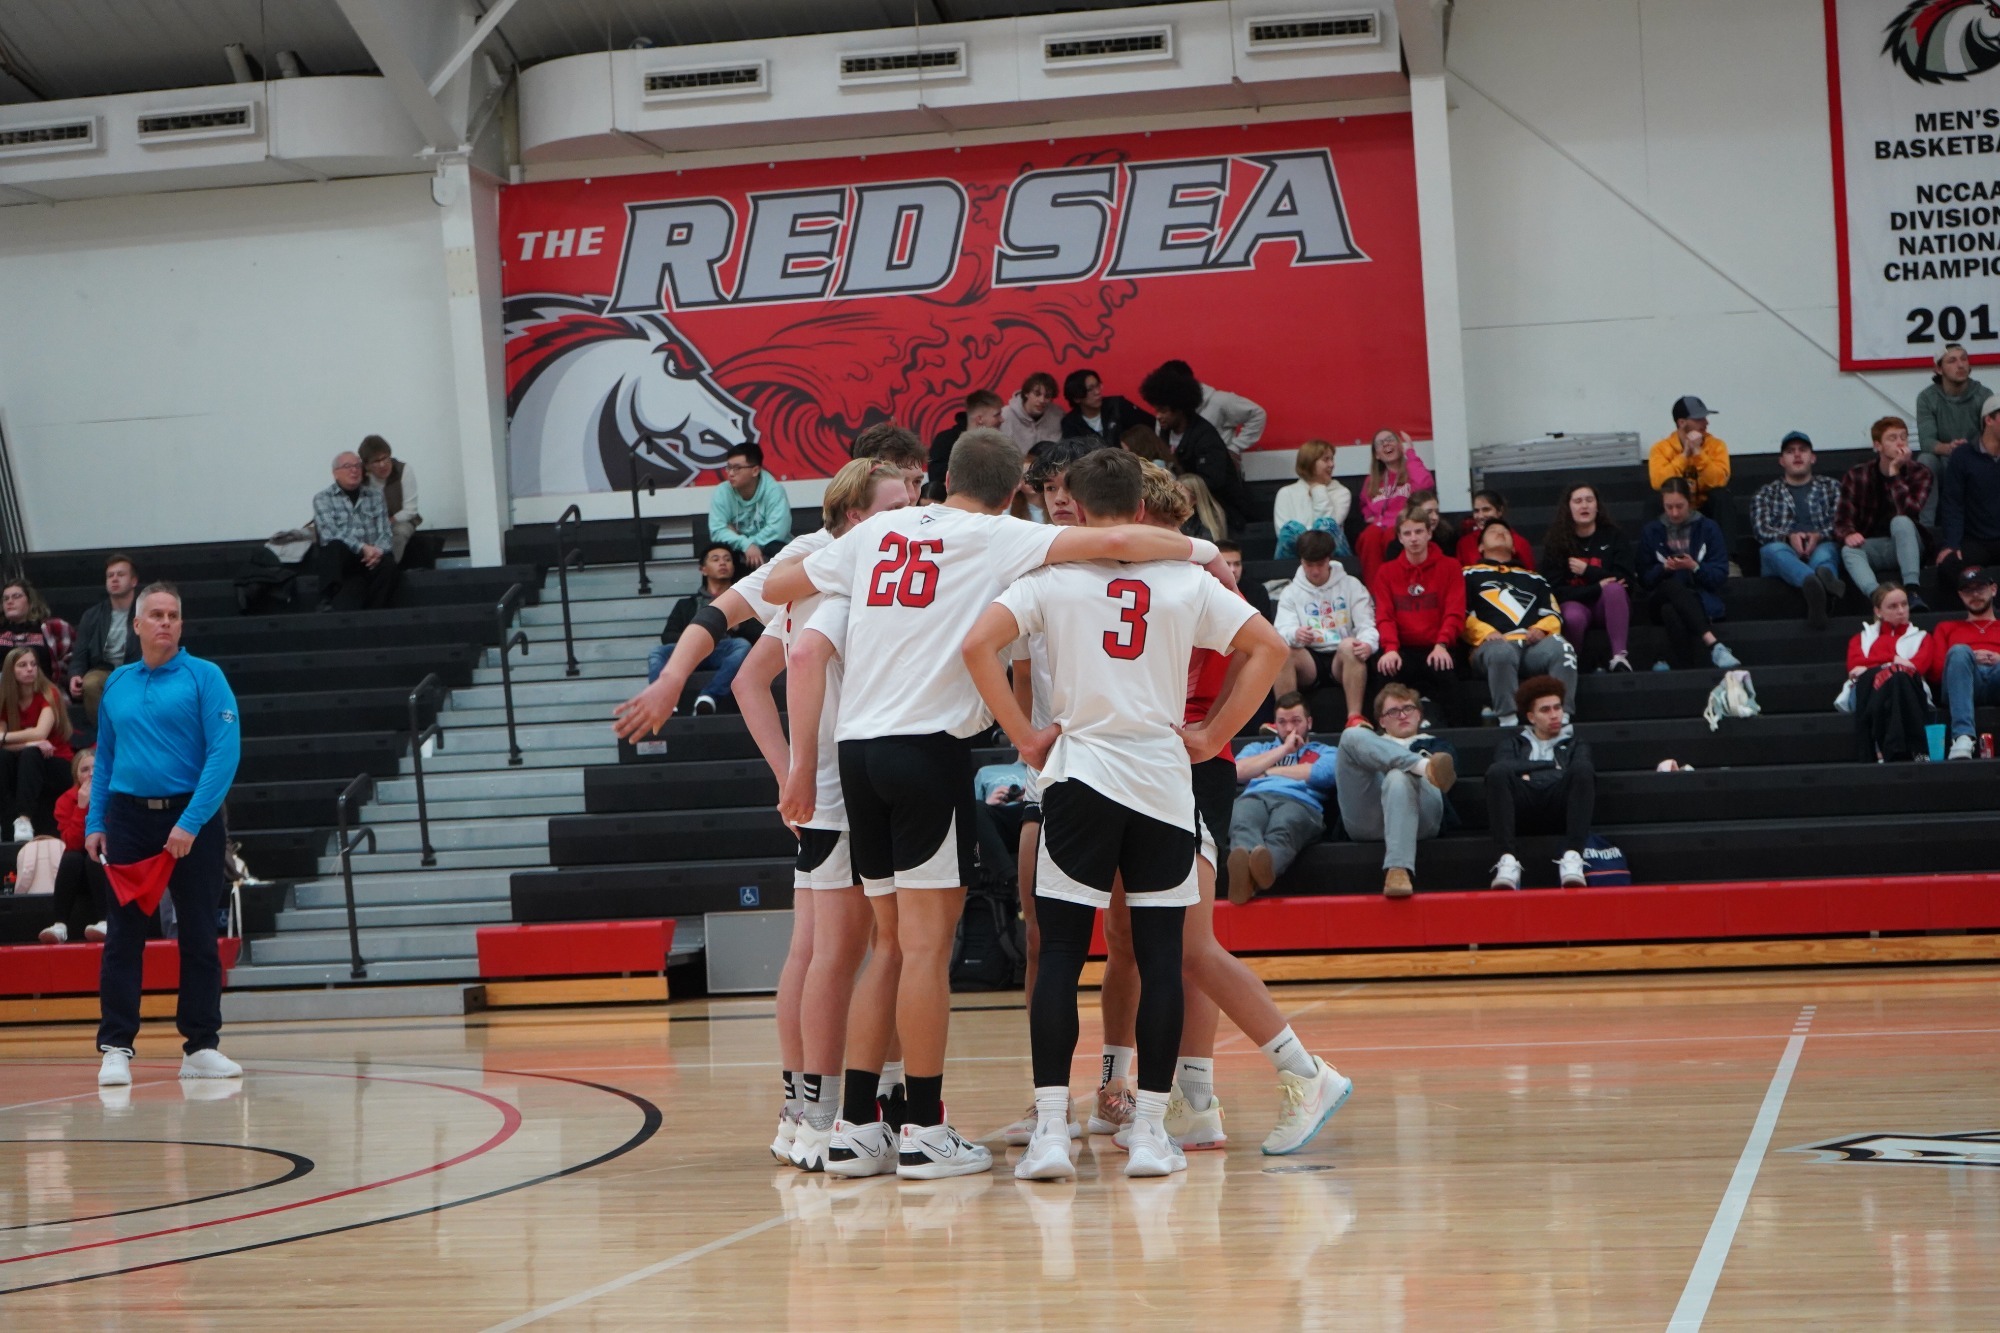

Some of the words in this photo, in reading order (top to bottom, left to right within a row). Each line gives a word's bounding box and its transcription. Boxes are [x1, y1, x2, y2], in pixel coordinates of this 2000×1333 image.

[1915, 108, 2000, 132] MEN'S
[1875, 134, 2000, 159] BASKETB
[517, 226, 605, 260] THE
[601, 177, 968, 317] RED
[992, 148, 1373, 288] SEA
[1899, 232, 2000, 255] NATION
[867, 531, 943, 608] 26
[1103, 578, 1150, 660] 3
